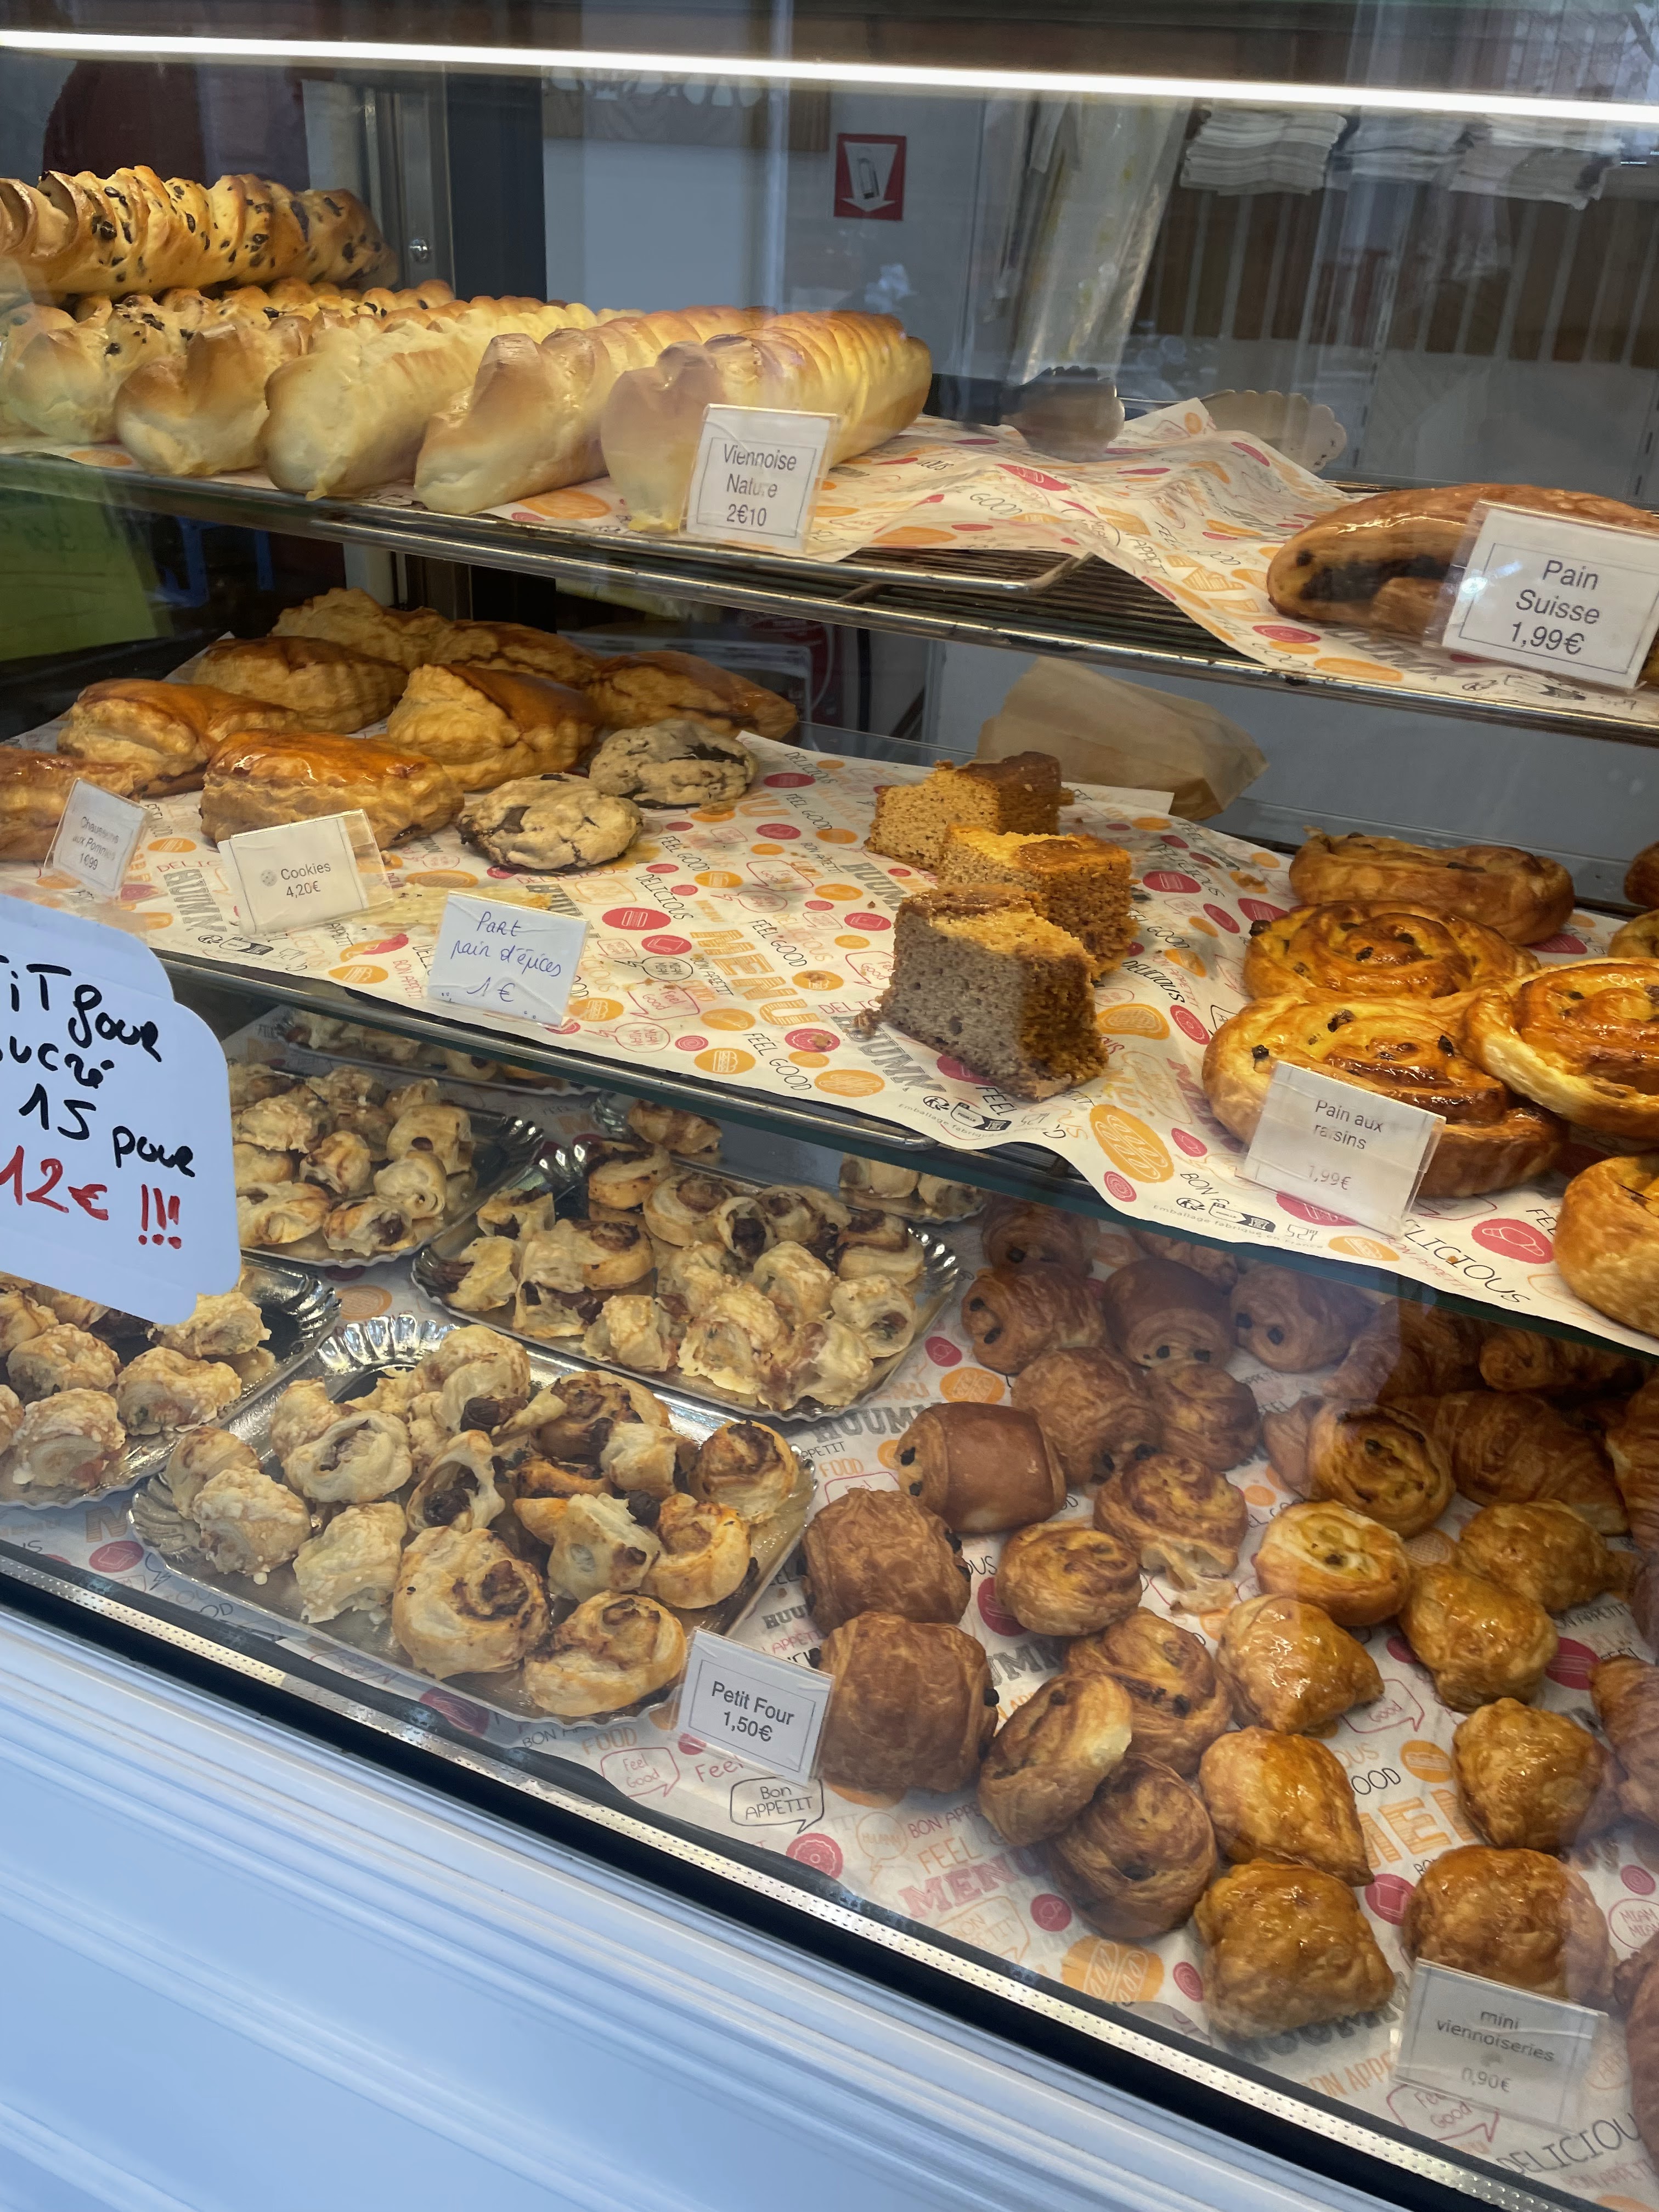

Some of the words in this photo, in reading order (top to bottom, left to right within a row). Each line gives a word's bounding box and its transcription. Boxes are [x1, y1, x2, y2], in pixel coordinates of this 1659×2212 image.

[724, 443, 797, 471] Viennoise
[726, 504, 767, 526] 2€10
[969, 494, 1023, 516] GOOD
[1542, 560, 1599, 590] Pain
[1516, 589, 1600, 625] Suisse
[1510, 622, 1585, 656] 1,99€
[802, 810, 832, 830] GOOD
[658, 836, 684, 853] FEEL
[676, 853, 710, 871] GOOD
[281, 862, 331, 881] Cookies
[286, 881, 321, 899] 4,20€
[635, 874, 693, 920] DELICIOUS
[476, 911, 521, 936] Part
[450, 940, 490, 959] pain
[748, 919, 778, 939] FEEL
[771, 940, 807, 967] GOOD
[1147, 926, 1190, 949] GOOD
[690, 929, 820, 1026] MENU
[1122, 960, 1185, 1003] DELICIOUS
[498, 983, 515, 1002] €
[642, 994, 673, 1010] Good
[0, 1035, 114, 1089] ucré
[743, 1033, 778, 1056] FEEL
[769, 1058, 812, 1091] GOOD
[18, 1082, 97, 1141] 15
[975, 1086, 1017, 1116] FEEL
[898, 1103, 949, 1125] Emballage
[1315, 1099, 1350, 1122] Pain
[1355, 1114, 1384, 1133] aux
[1313, 1125, 1367, 1149] rasins
[0, 1145, 109, 1221] 12€
[1180, 1173, 1220, 1195] BON
[1308, 1165, 1351, 1190] 1,99€
[1153, 1205, 1211, 1223] Emballage
[819, 1458, 864, 1478] FOOD
[712, 1680, 750, 1710] Petit
[753, 1696, 795, 1727] Four
[522, 1727, 556, 1749] BON
[723, 1711, 773, 1743] 1,50€
[582, 1728, 638, 1756] FOOD
[623, 1756, 650, 1771] Feel
[625, 1768, 661, 1789] Good
[760, 1786, 792, 1800] Bon
[746, 1796, 814, 1820] APPETIT
[908, 1816, 943, 1839] BON
[917, 1836, 983, 1874] FEEL
[1481, 2011, 1520, 2030] mini
[1436, 2019, 1555, 2063] viennoiseries
[1462, 2067, 1511, 2092] 0,90€
[1430, 2101, 1473, 2129] Good
